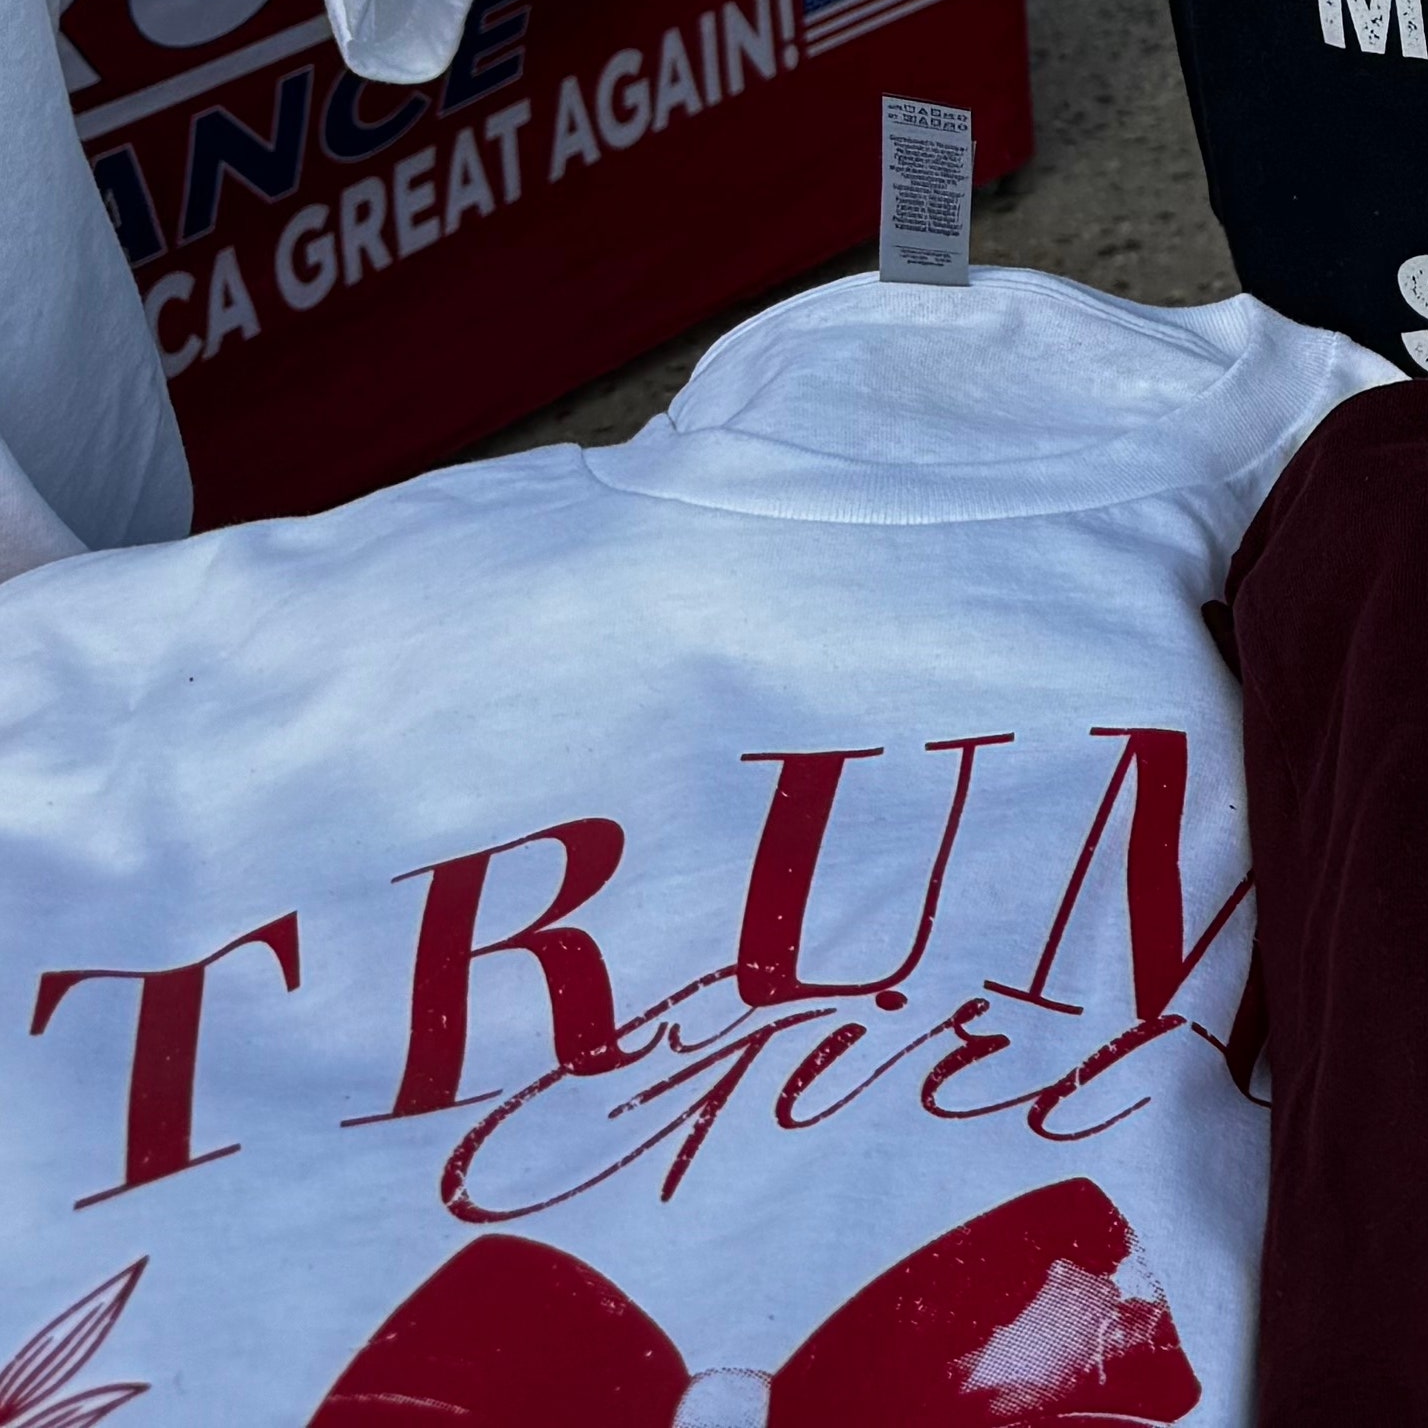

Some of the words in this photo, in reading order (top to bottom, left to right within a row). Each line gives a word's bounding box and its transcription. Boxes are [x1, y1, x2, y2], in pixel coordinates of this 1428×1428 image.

[274, 99, 532, 311] GREAT
[30, 726, 1262, 1212] TRUM
[440, 964, 1185, 1224] Girl
